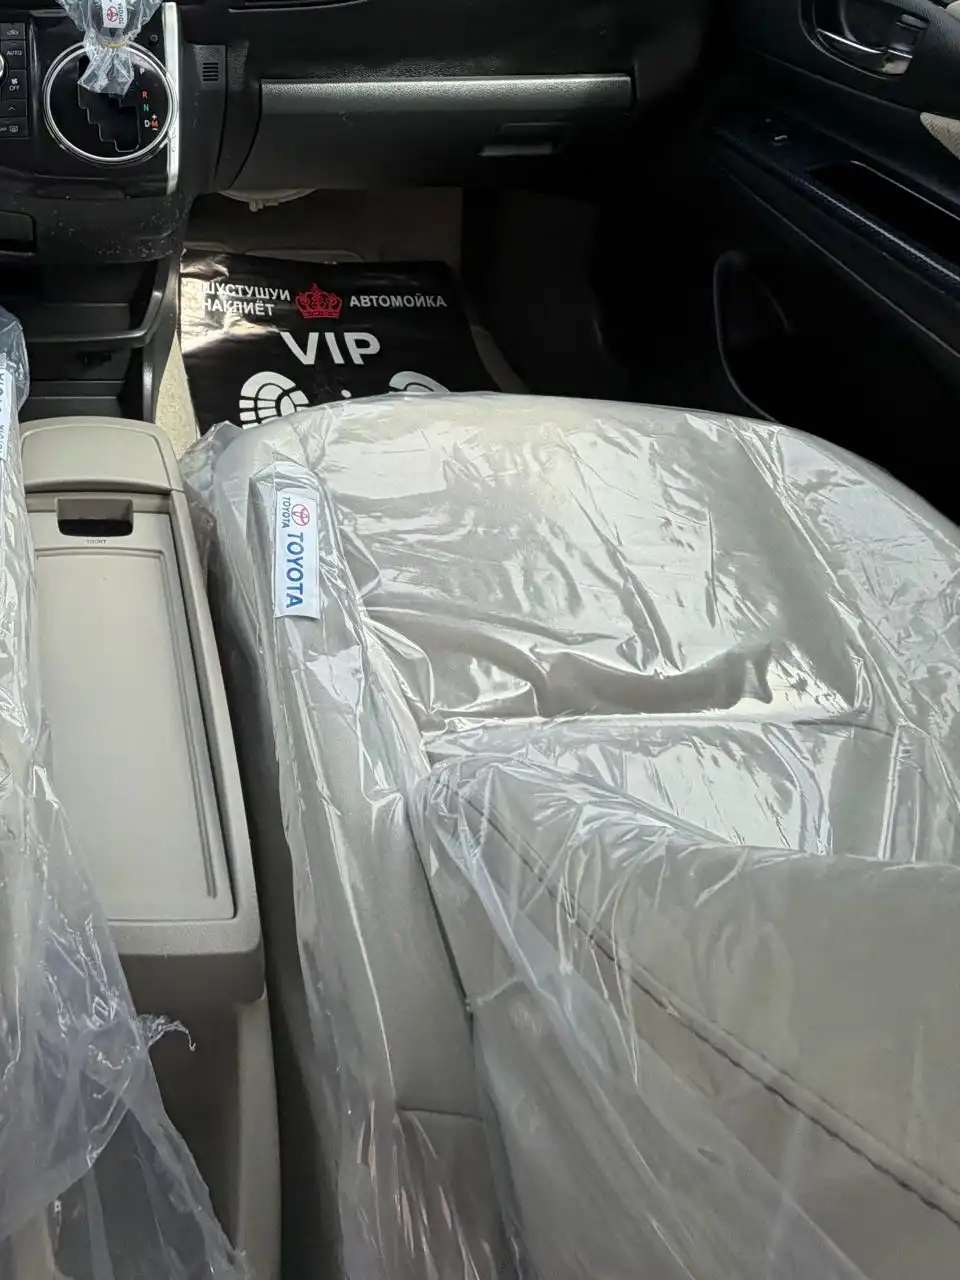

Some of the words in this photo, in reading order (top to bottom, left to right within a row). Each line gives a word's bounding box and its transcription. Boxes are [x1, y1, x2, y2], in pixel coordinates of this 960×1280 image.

[143, 103, 149, 112] N
[349, 293, 447, 308] АВТОМОЙКА
[280, 331, 381, 365] VIP
[281, 496, 292, 529] TOYOTA
[286, 532, 305, 609] TOYOTA
